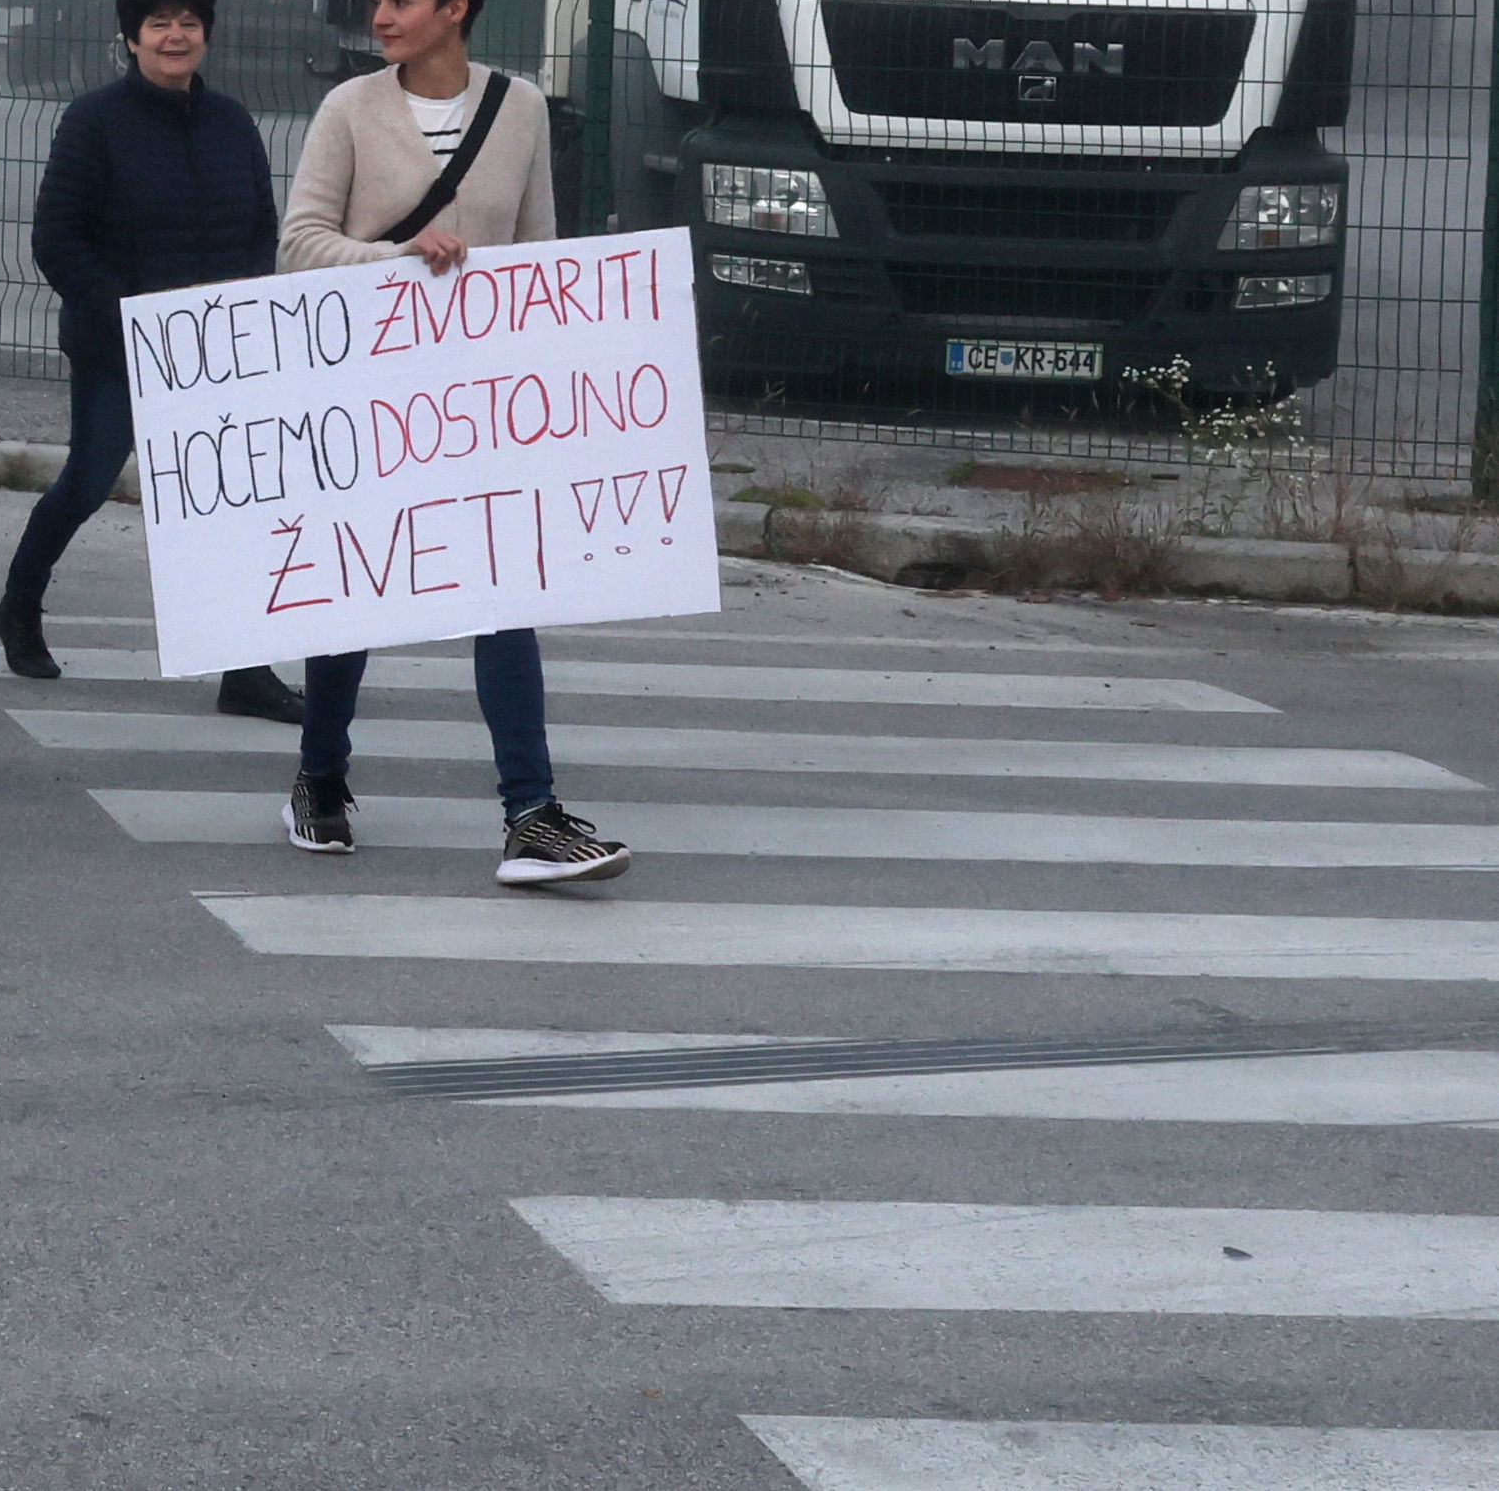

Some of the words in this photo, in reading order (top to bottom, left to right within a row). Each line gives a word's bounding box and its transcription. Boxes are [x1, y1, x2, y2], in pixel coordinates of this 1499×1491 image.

[952, 38, 1124, 74] MAN
[131, 290, 352, 398] NOČEMO
[369, 249, 660, 356] ŽIVOTARITI
[147, 405, 359, 525] HOČEMO
[369, 364, 668, 479] DOSTOJNO
